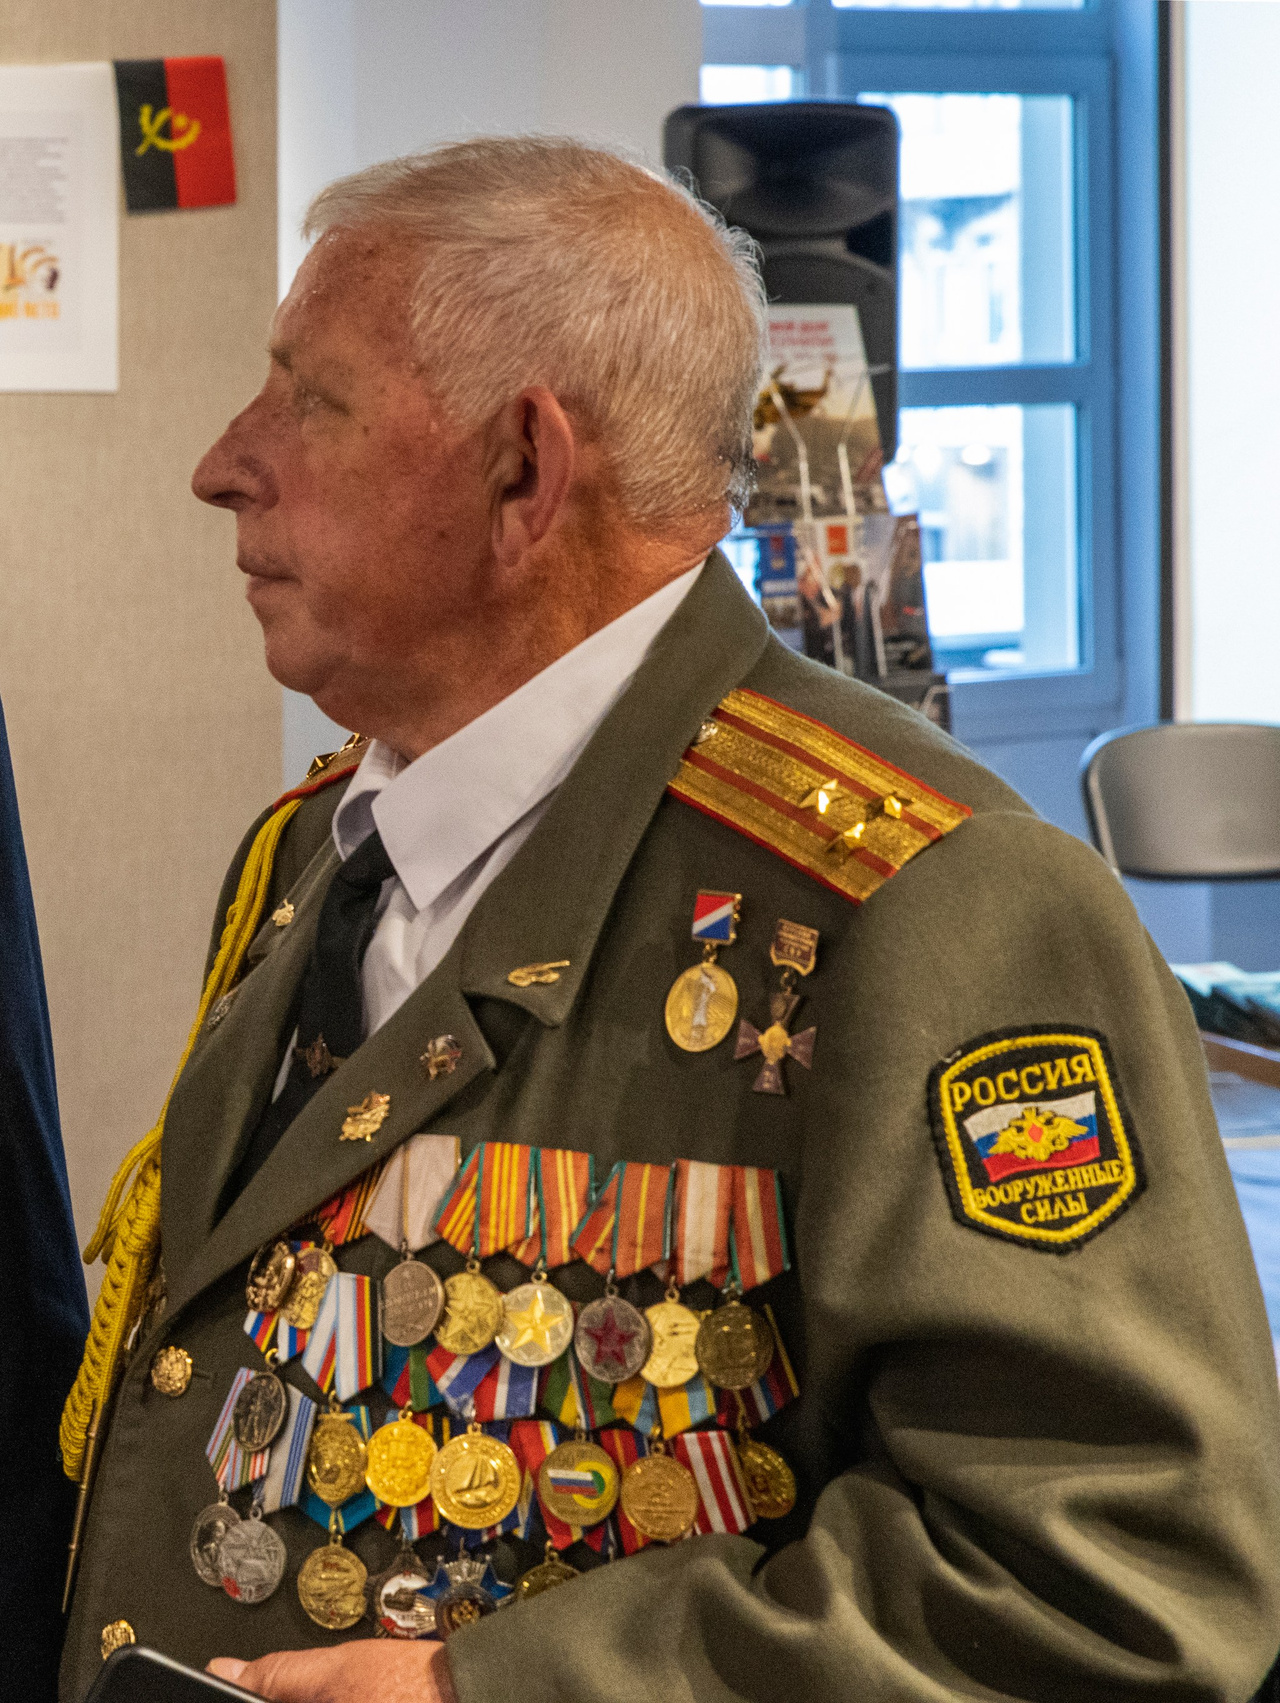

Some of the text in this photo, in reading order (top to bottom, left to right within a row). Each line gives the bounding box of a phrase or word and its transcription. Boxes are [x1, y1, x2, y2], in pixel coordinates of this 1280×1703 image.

[949, 1053, 1096, 1112] РОССИЯ
[972, 1159, 1126, 1210] ВООРУЖЕННЫЕ
[1020, 1191, 1089, 1225] СИЛЫ
